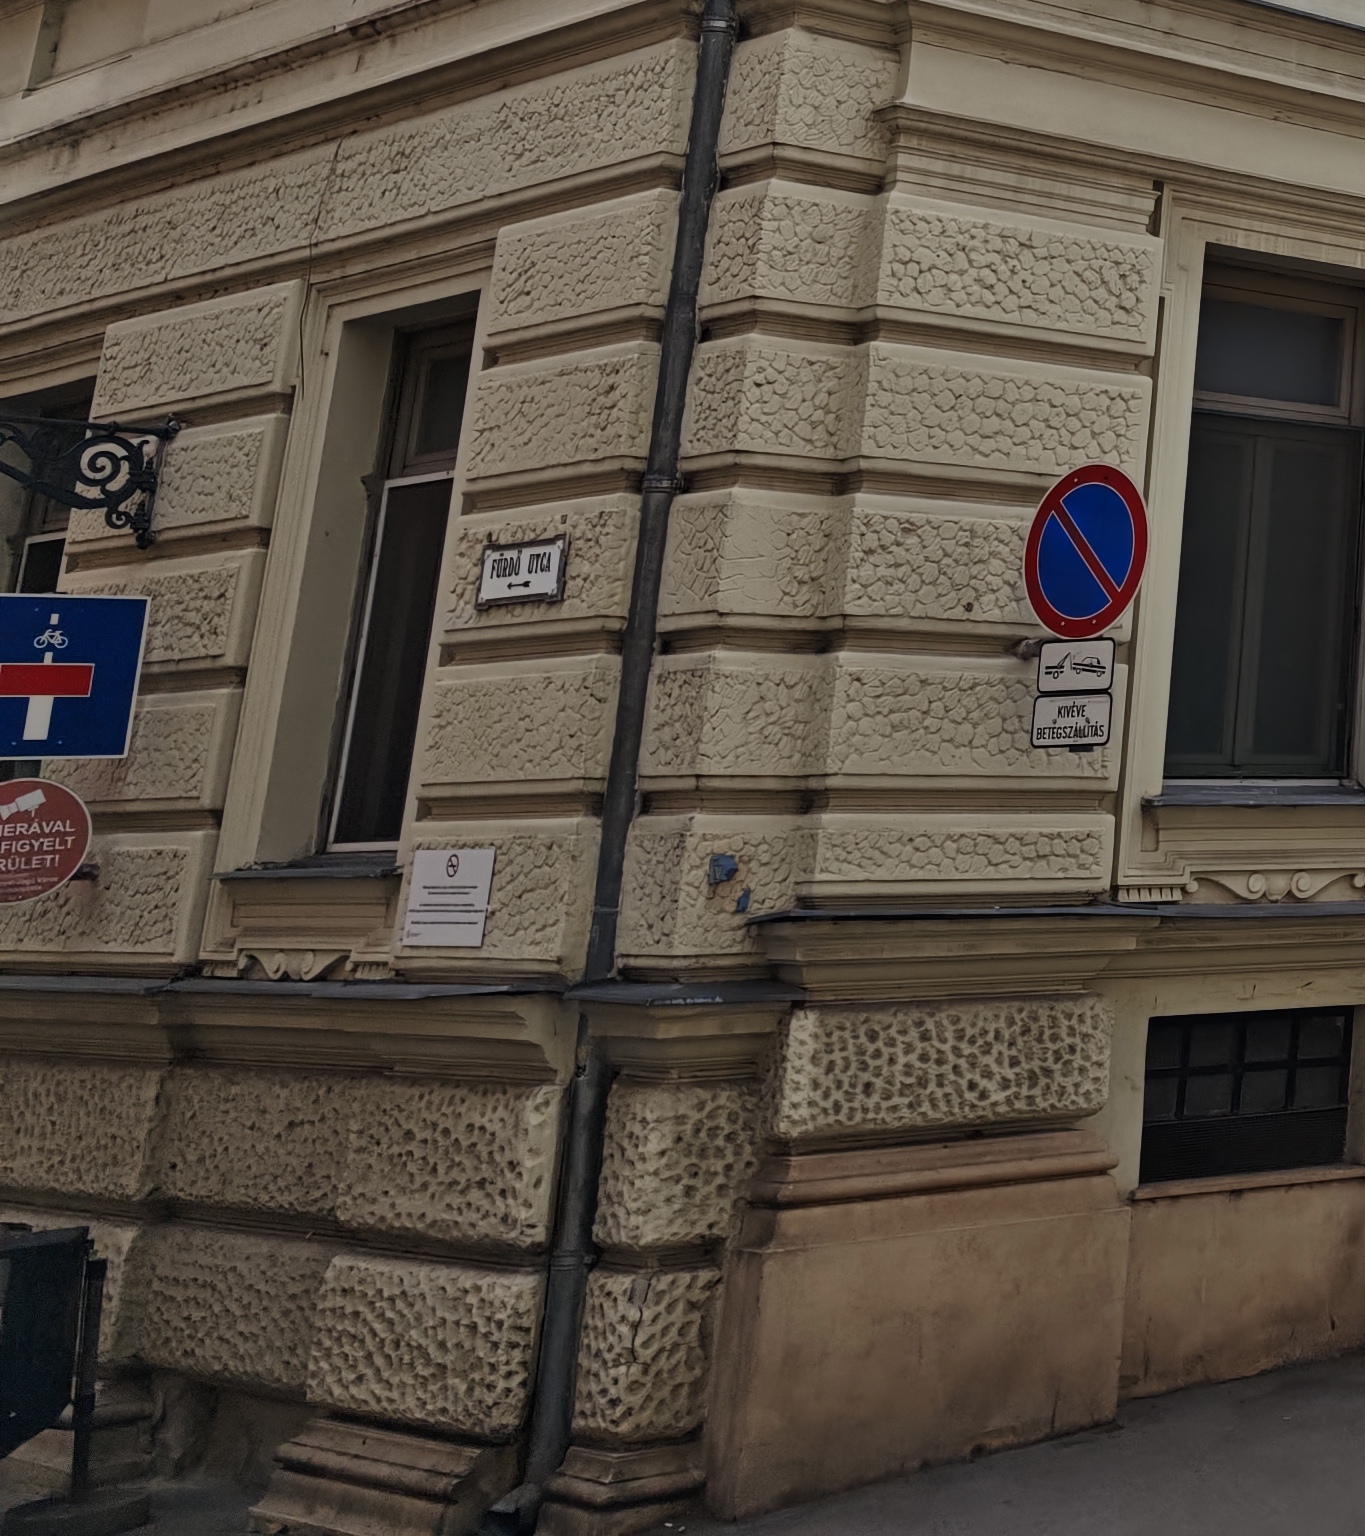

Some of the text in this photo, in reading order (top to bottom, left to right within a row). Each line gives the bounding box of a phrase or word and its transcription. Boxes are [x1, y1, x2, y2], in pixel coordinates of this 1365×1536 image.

[490, 549, 552, 579] FÜRDŐ UTCA
[1057, 701, 1087, 719] KIVÉVE
[0, 819, 76, 837] ERÁVAL
